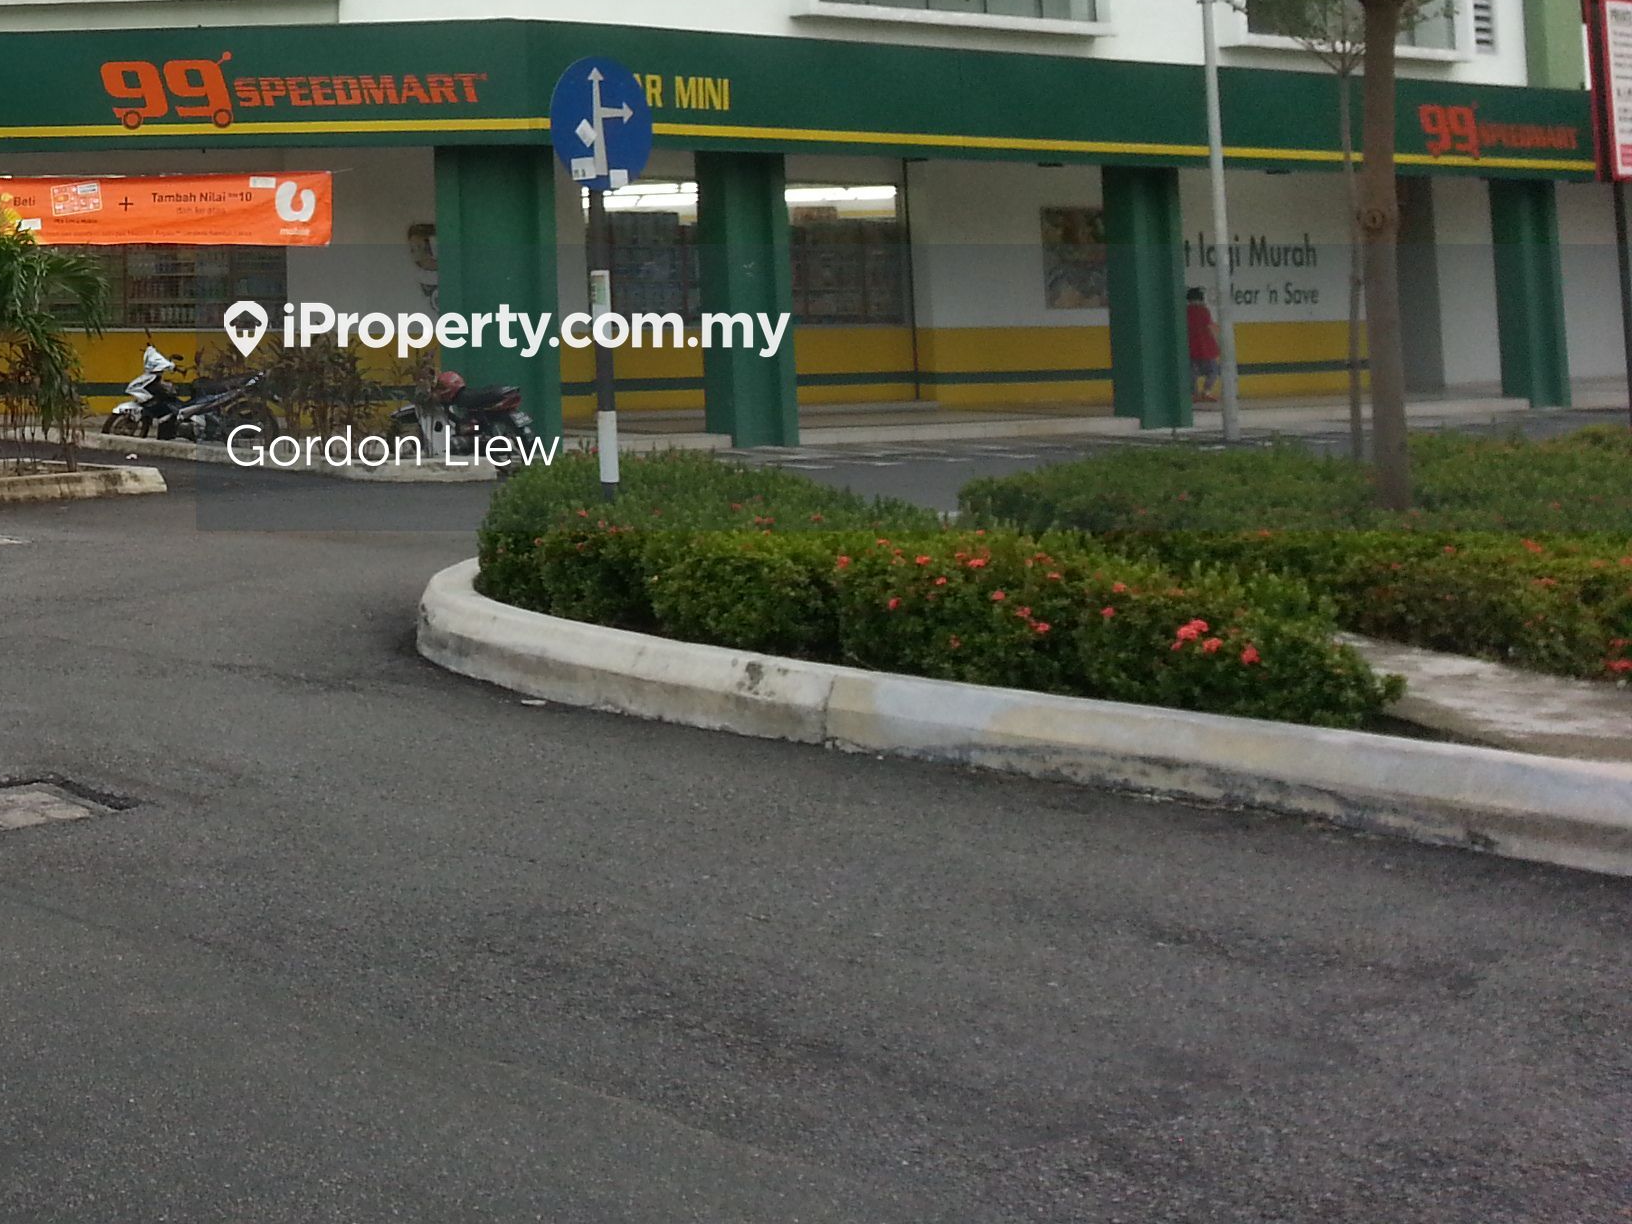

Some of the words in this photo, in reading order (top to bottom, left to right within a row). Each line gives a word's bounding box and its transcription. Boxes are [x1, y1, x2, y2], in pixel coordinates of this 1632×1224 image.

[99, 59, 231, 130] 99
[233, 74, 488, 107] SPEEDMART
[675, 76, 731, 111] MINI
[1418, 102, 1480, 160] 99
[152, 192, 196, 203] Tambah
[200, 191, 226, 202] Nilai
[1249, 232, 1317, 267] Murah
[1284, 282, 1319, 305] Save
